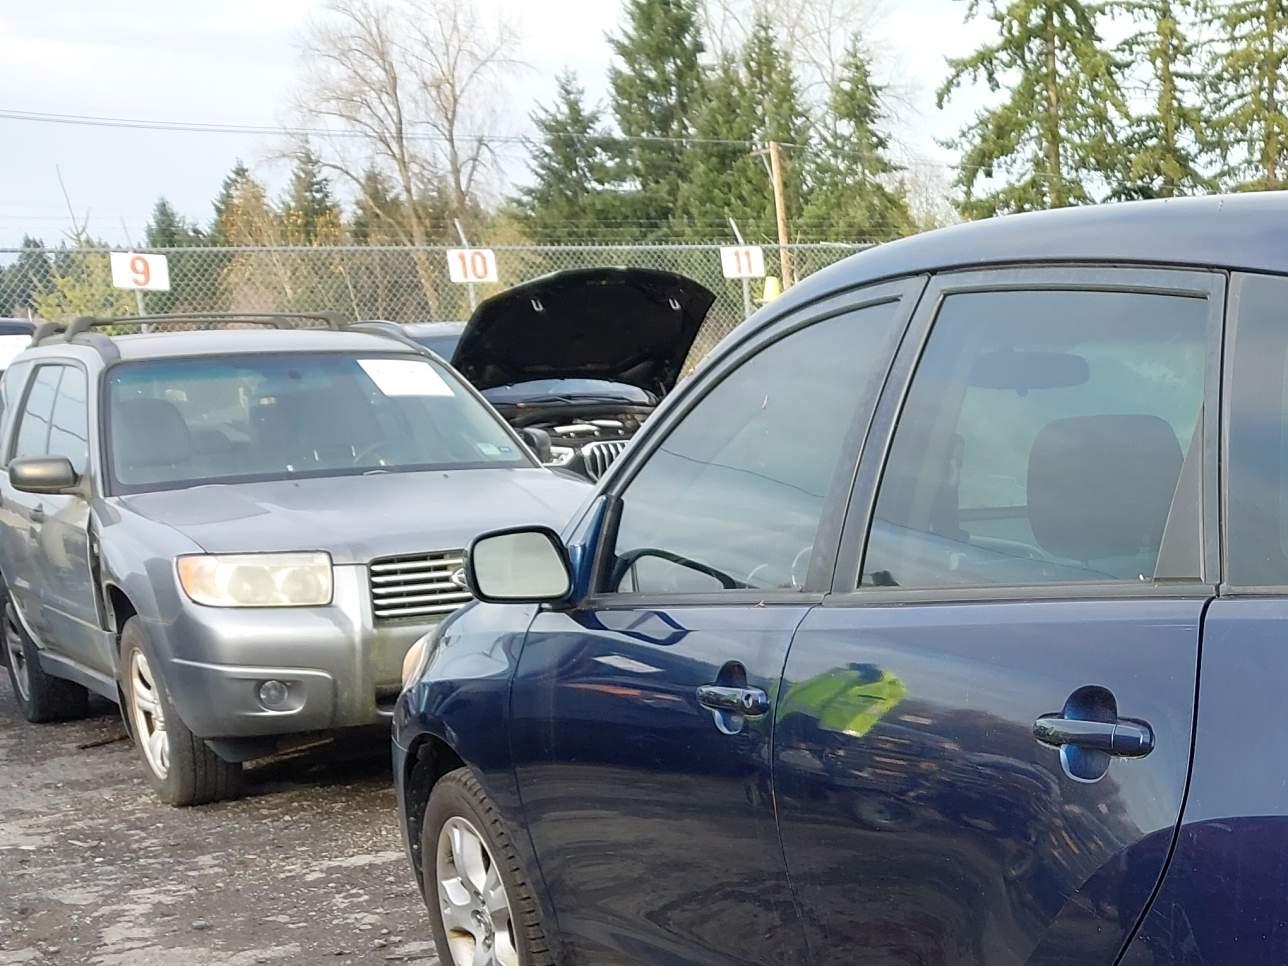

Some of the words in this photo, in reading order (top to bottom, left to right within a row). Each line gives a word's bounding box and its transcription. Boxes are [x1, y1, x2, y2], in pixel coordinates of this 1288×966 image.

[130, 255, 150, 287] 9
[457, 251, 488, 280] 10
[734, 249, 753, 274] 11
